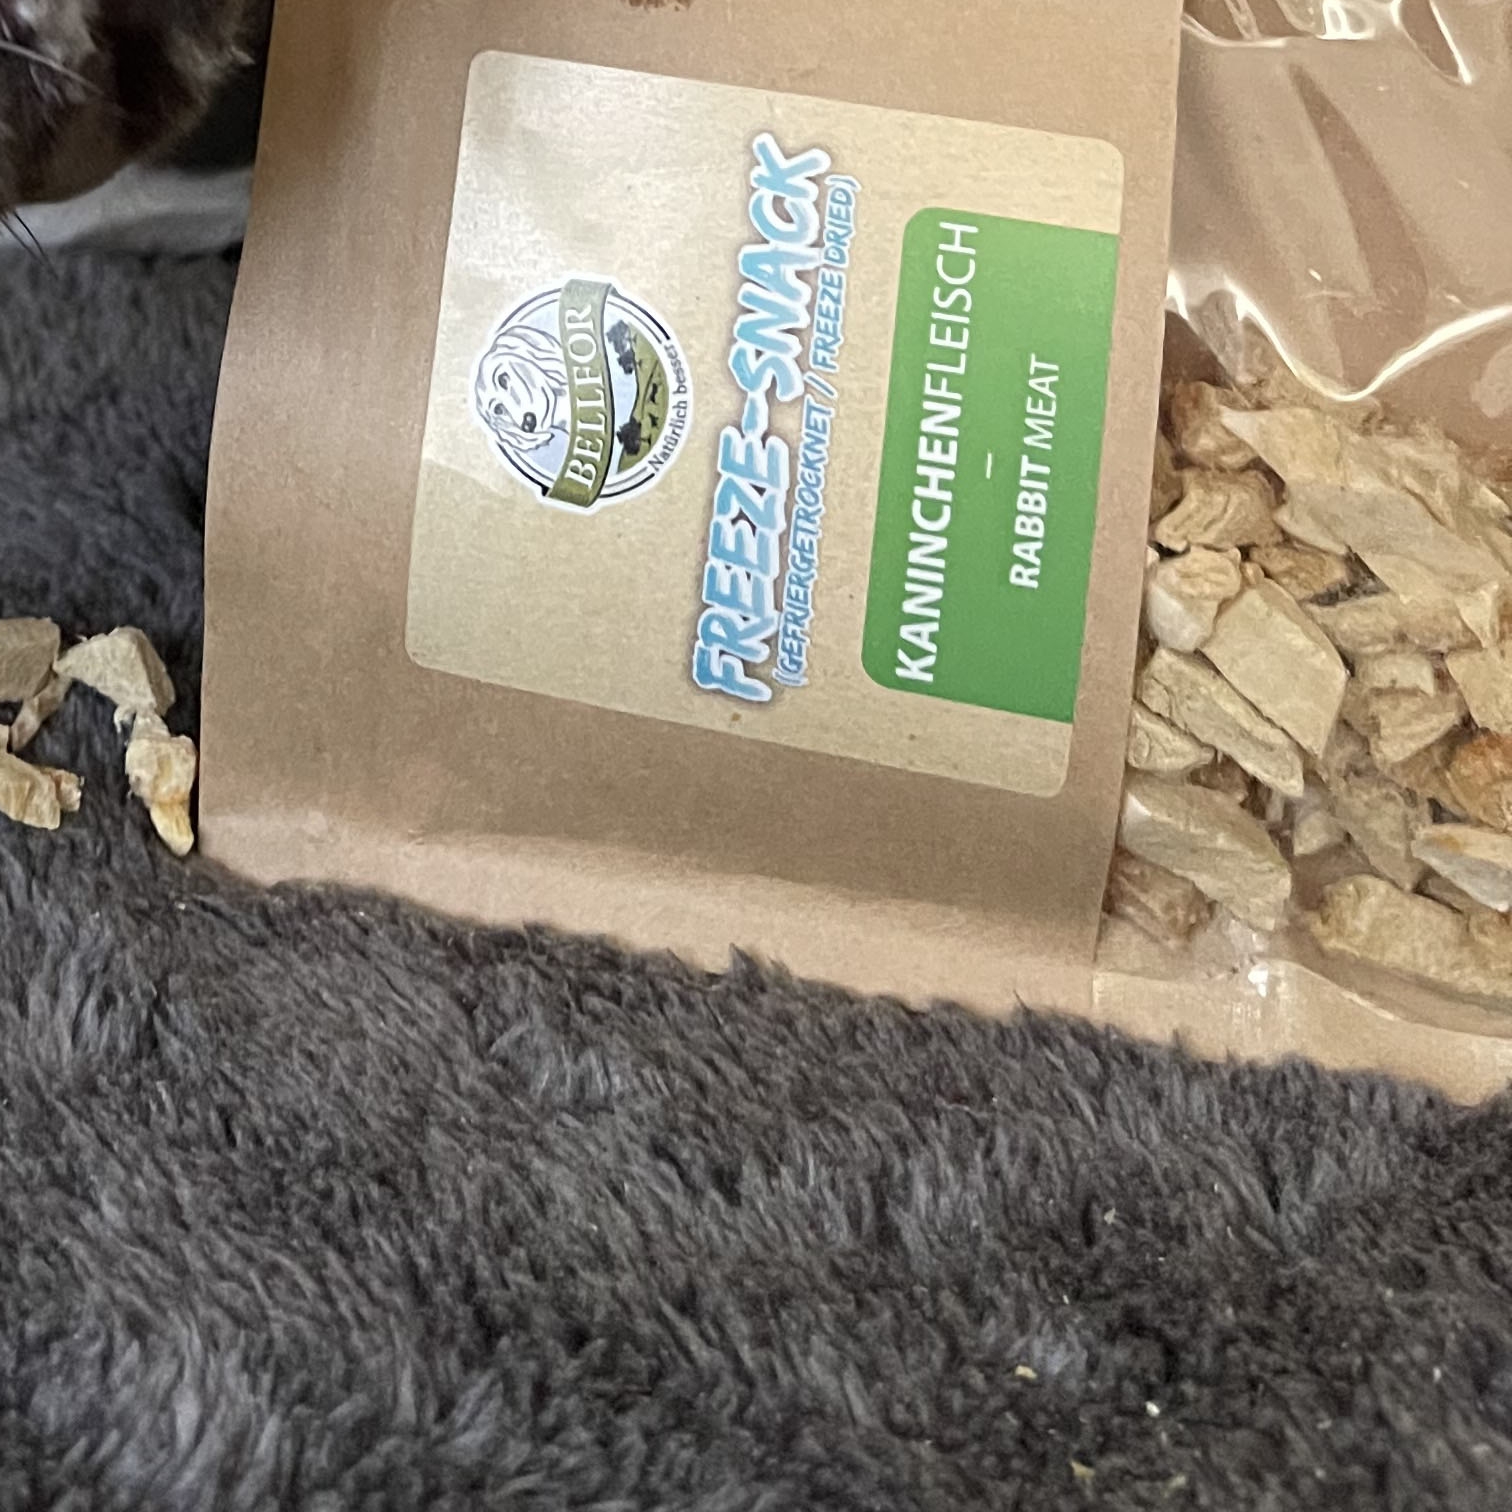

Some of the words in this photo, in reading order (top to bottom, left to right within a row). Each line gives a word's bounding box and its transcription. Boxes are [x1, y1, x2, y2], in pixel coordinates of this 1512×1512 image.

[823, 174, 862, 268] DRIED)
[665, 342, 688, 395] besser
[809, 268, 845, 371] FREEZE
[564, 304, 607, 489] BELLFOR
[647, 400, 688, 473] Natürlich
[692, 132, 832, 702] FREEZE-SNACK
[1023, 353, 1060, 451] MEAT
[895, 221, 979, 683] KANINCHENFLEISCH
[1009, 454, 1051, 589] RABBIT
